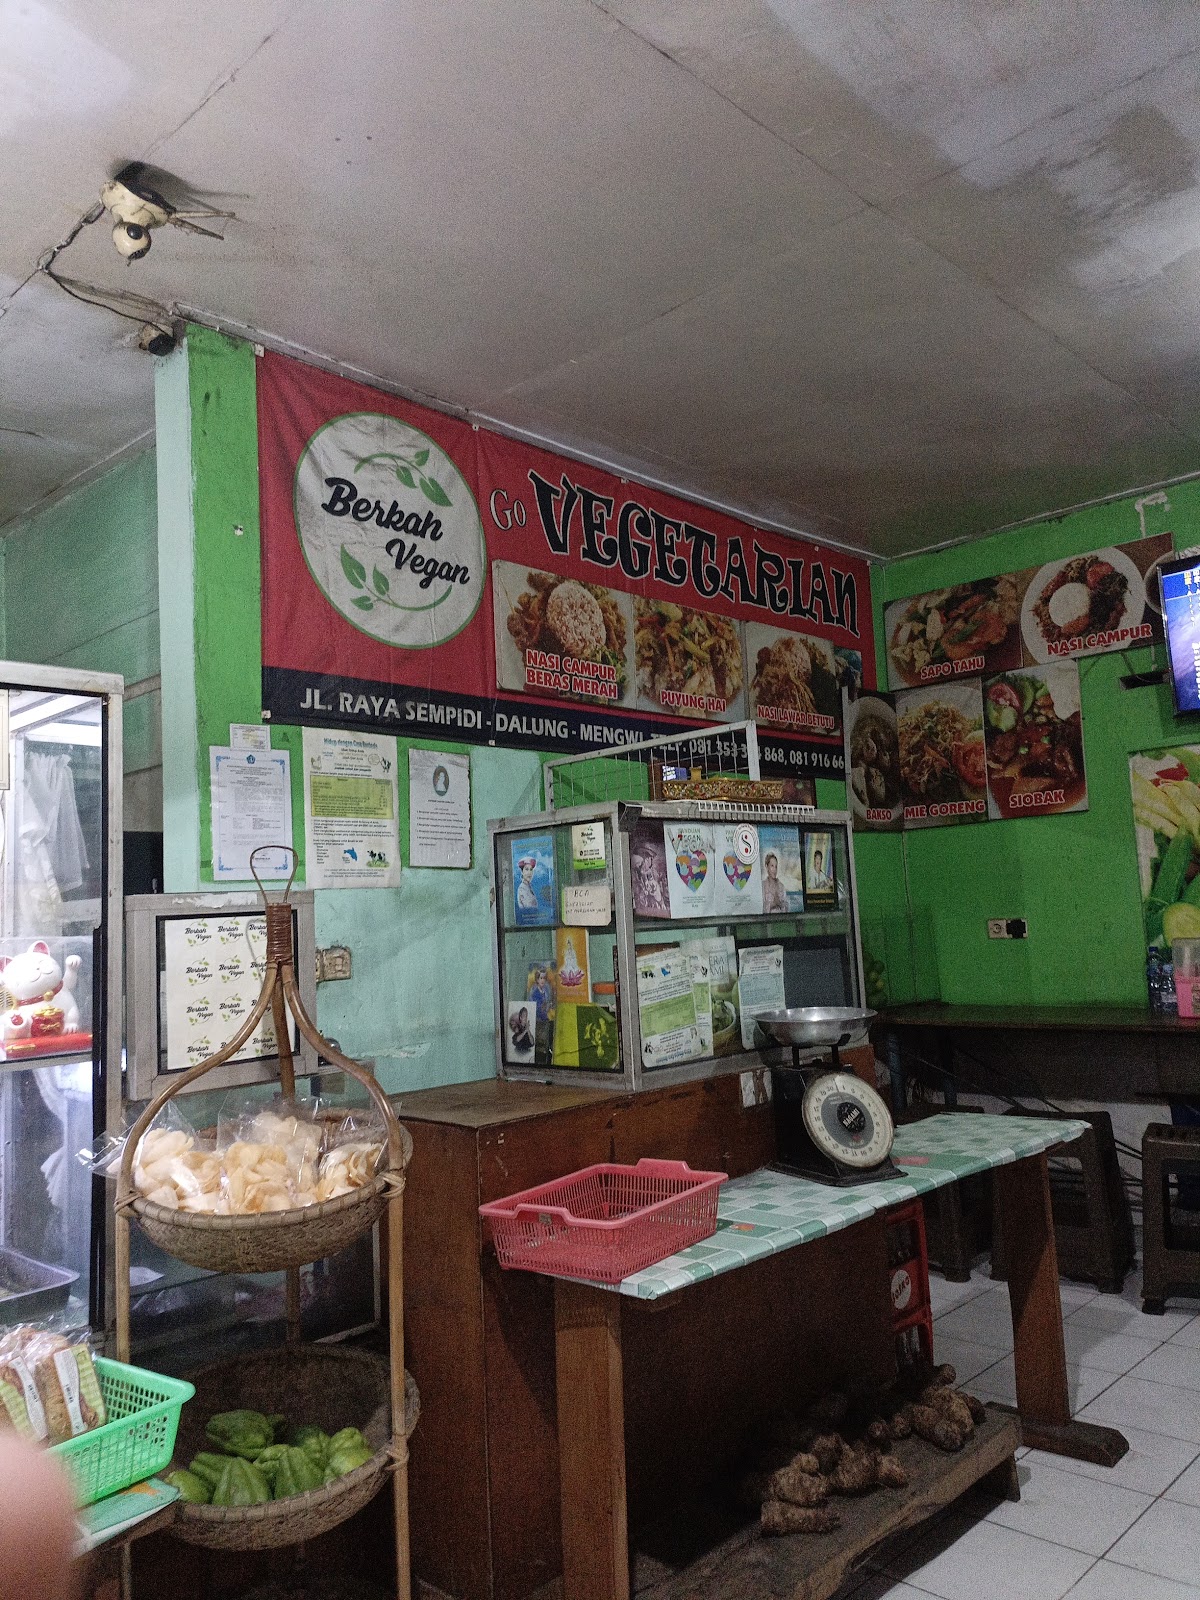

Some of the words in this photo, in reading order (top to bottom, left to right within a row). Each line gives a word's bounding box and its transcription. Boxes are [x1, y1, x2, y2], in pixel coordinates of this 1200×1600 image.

[321, 476, 444, 541] Berkah
[385, 538, 470, 589] Vegan
[489, 489, 526, 530] Go
[527, 469, 860, 639] VEGETARIAN
[1047, 637, 1084, 655] NASI
[1085, 623, 1153, 649] CAMPUR
[526, 649, 560, 671] NASI
[562, 657, 617, 682] CAMPUR
[920, 662, 952, 680] SAPO
[953, 656, 985, 674] TAHU
[526, 667, 570, 691] BERAS
[572, 676, 618, 699] MERAH
[660, 690, 707, 710] PUYUNG
[708, 697, 727, 712] HAI
[757, 705, 779, 720] NASI
[779, 708, 807, 724] LAWAR
[300, 688, 333, 710] JL.
[339, 692, 401, 719] RAYA
[405, 701, 482, 729] SEMPIDI
[495, 713, 568, 738] DALUNG
[790, 750, 808, 765] 081
[811, 752, 830, 768] 916
[903, 805, 927, 820] MIE
[928, 799, 986, 818] GORENG
[1008, 789, 1065, 809] SIOBAK
[866, 808, 892, 822] BAKSO
[842, 1107, 860, 1127] NAGAMI
